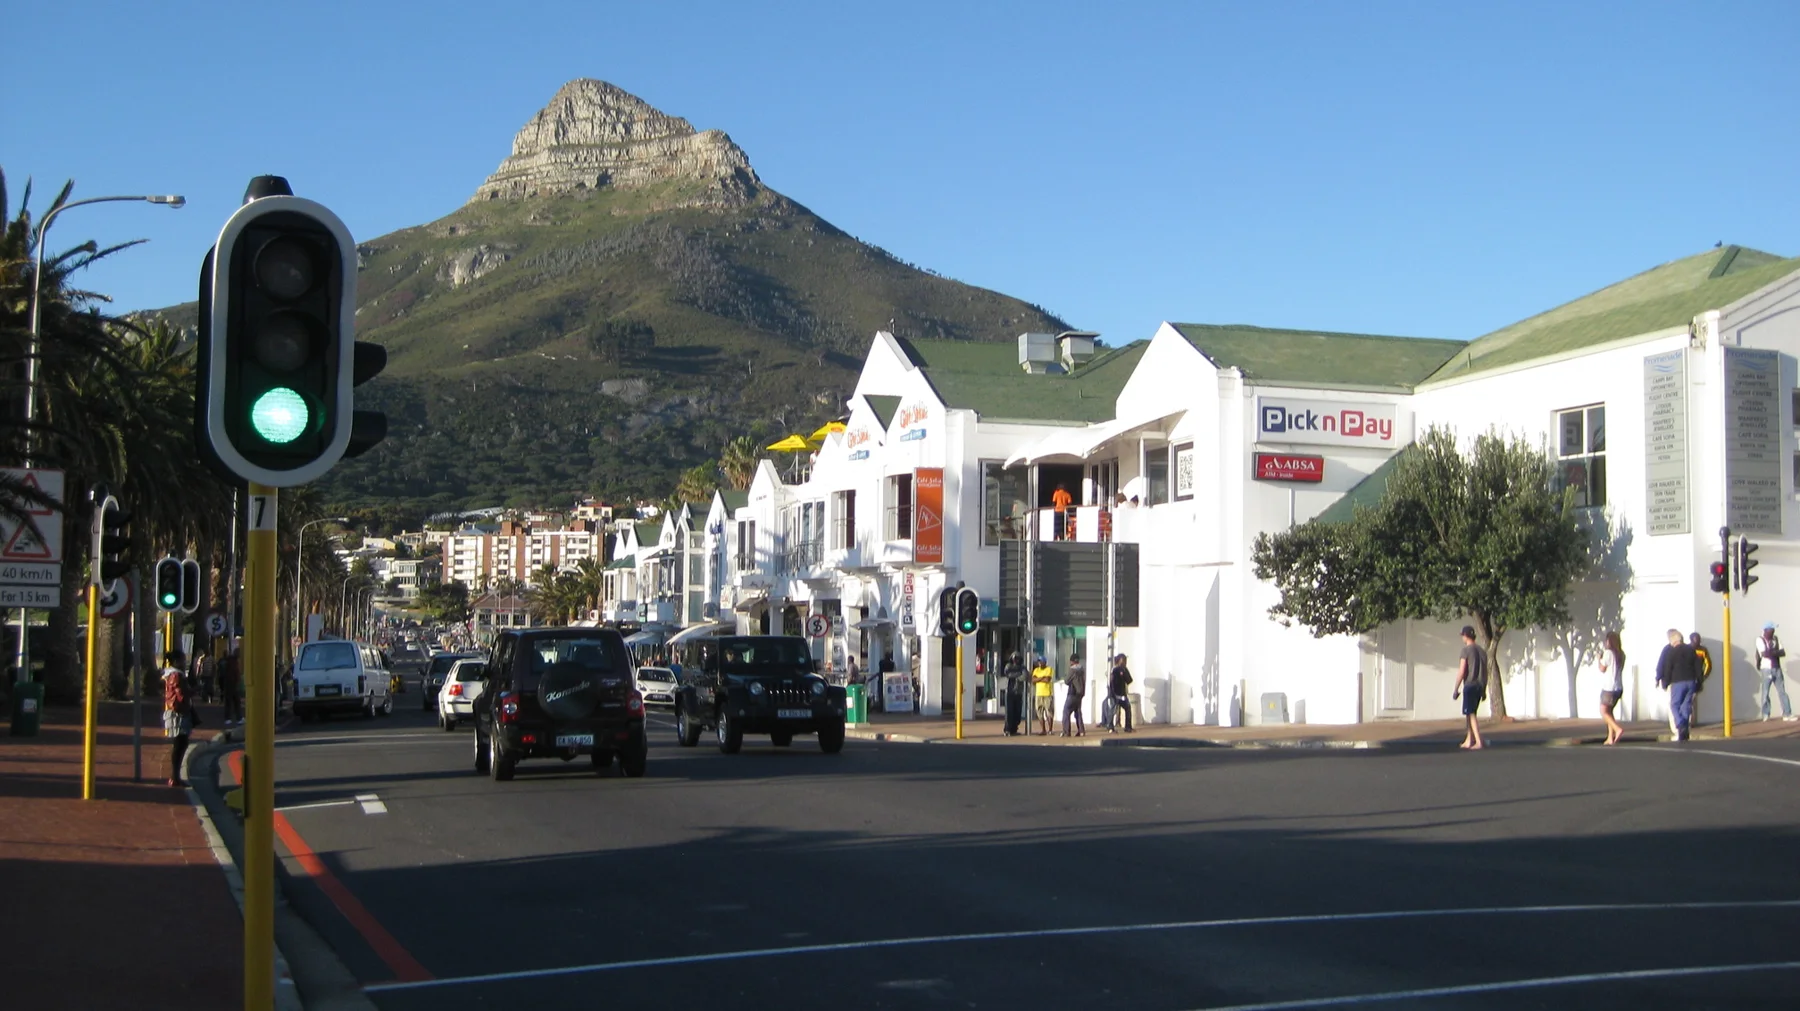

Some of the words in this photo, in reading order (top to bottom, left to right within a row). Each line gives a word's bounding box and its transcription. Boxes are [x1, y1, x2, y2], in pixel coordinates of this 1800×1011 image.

[1262, 406, 1318, 432] Pick
[1322, 415, 1336, 432] n
[1340, 410, 1392, 440] Pay
[1284, 460, 1315, 471] ABSA
[255, 496, 266, 528] 7
[2, 568, 16, 578] 40
[21, 568, 52, 580] km/h
[904, 573, 914, 594] Pay
[2, 591, 16, 602] For
[20, 591, 32, 602] 1.5
[36, 591, 50, 602] km
[904, 603, 912, 624] Pick
[546, 680, 590, 702] Korando
